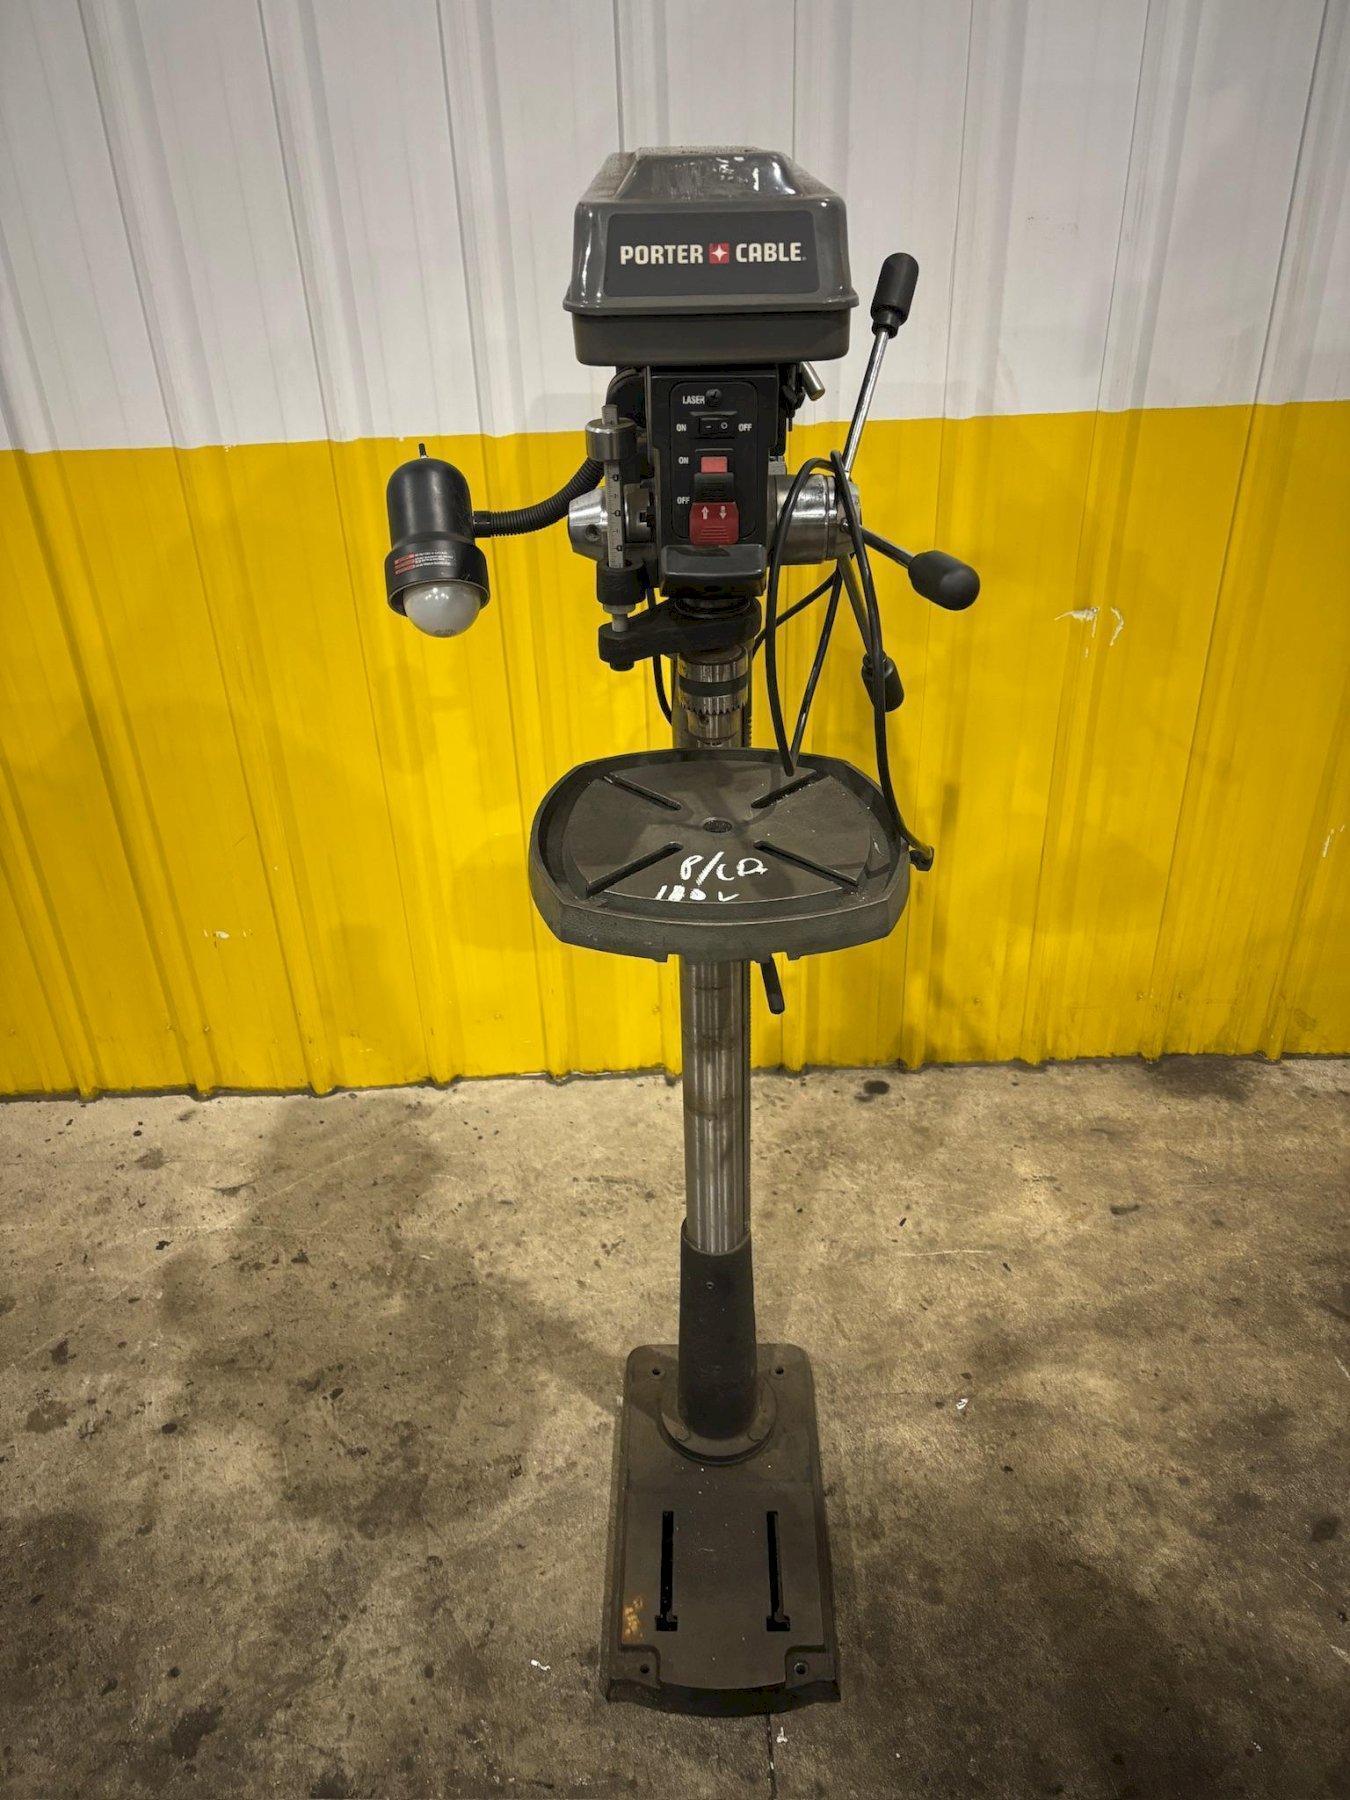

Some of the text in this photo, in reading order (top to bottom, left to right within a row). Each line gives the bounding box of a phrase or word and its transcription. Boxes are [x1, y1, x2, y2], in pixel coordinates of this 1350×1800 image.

[620, 242, 802, 265] PORTER CABLE
[682, 395, 706, 405] LASER
[675, 423, 753, 432] ON OFF
[678, 456, 689, 465] ON
[676, 496, 691, 505] OFF
